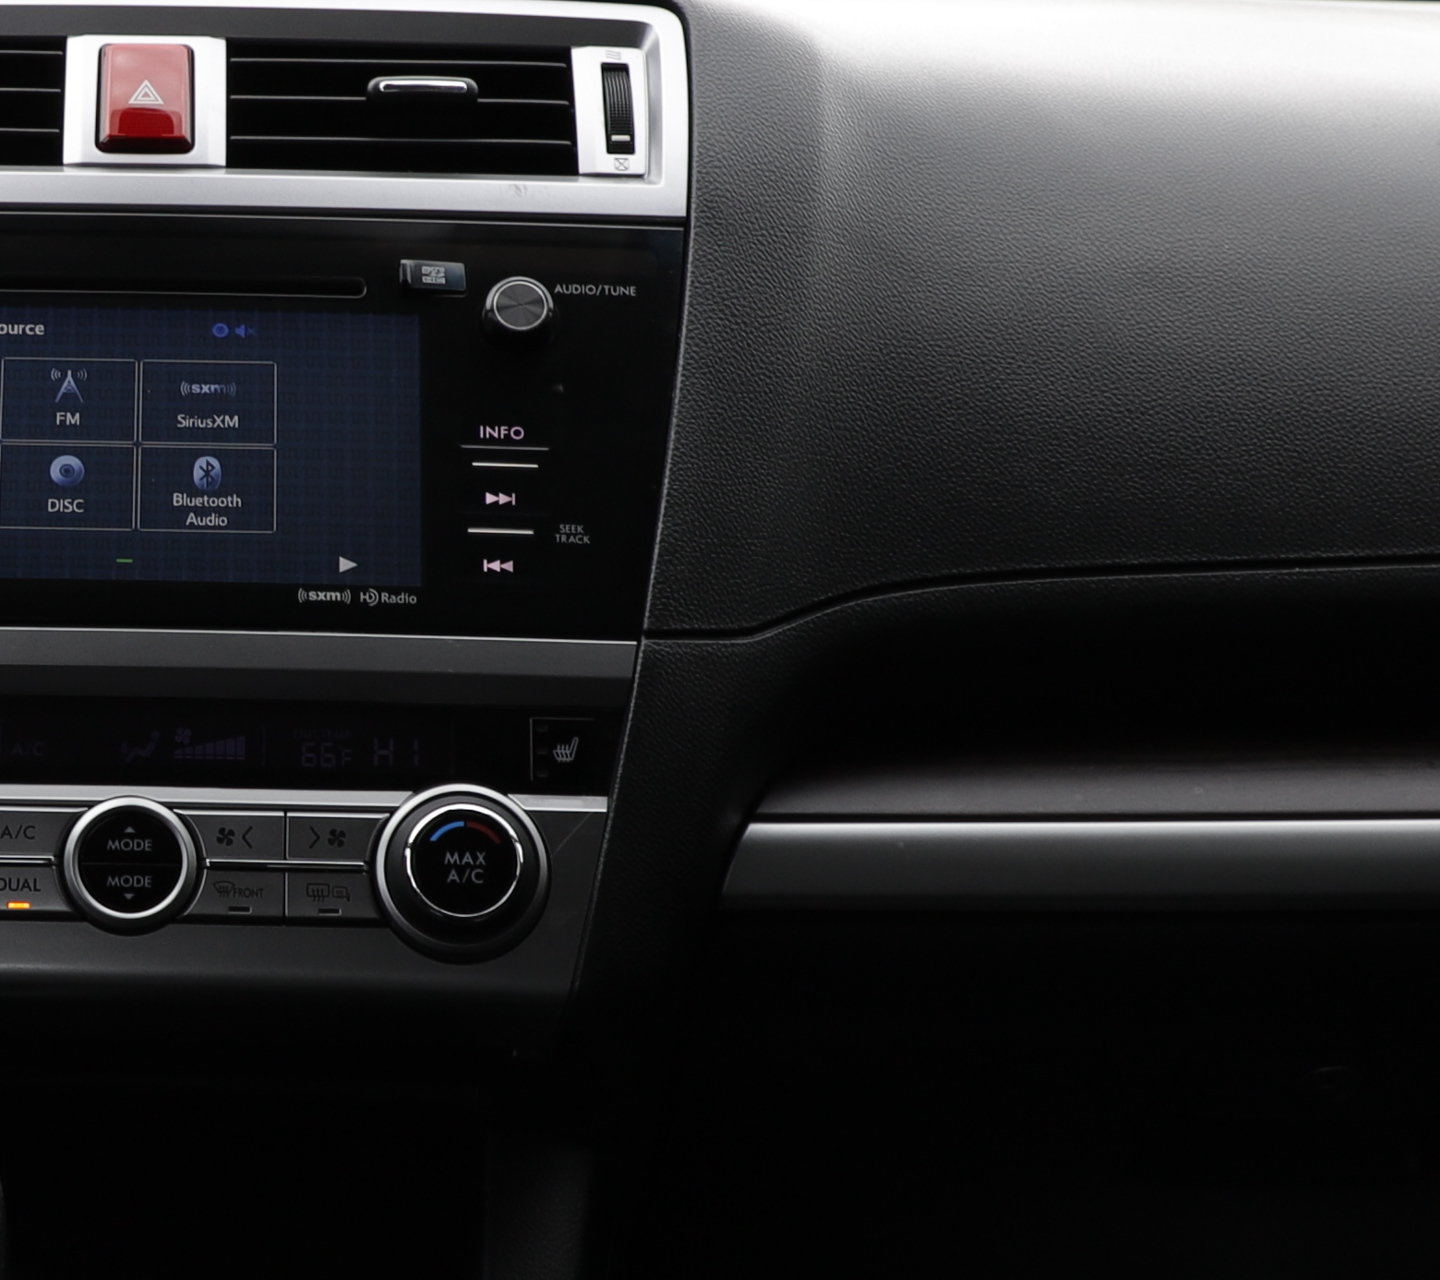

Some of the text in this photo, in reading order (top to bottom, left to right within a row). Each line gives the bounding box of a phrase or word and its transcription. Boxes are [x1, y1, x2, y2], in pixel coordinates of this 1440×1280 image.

[554, 283, 637, 297] AUDIO/TUNE
[56, 411, 80, 426] FM
[176, 414, 239, 429] SiriusXM
[479, 425, 525, 440] INFO
[47, 499, 85, 513] DISC
[172, 493, 242, 508] Bluetooth
[186, 512, 228, 527] Audio
[559, 523, 584, 534] SEEK
[555, 533, 591, 544] TRACK
[308, 591, 341, 601] sxm
[381, 592, 417, 604] Radio
[0, 825, 36, 840] A/C
[106, 838, 152, 852] MODE
[444, 851, 487, 866] MAX
[106, 875, 152, 888] MODE
[446, 869, 485, 884] A/C
[233, 887, 265, 899] FRONT
